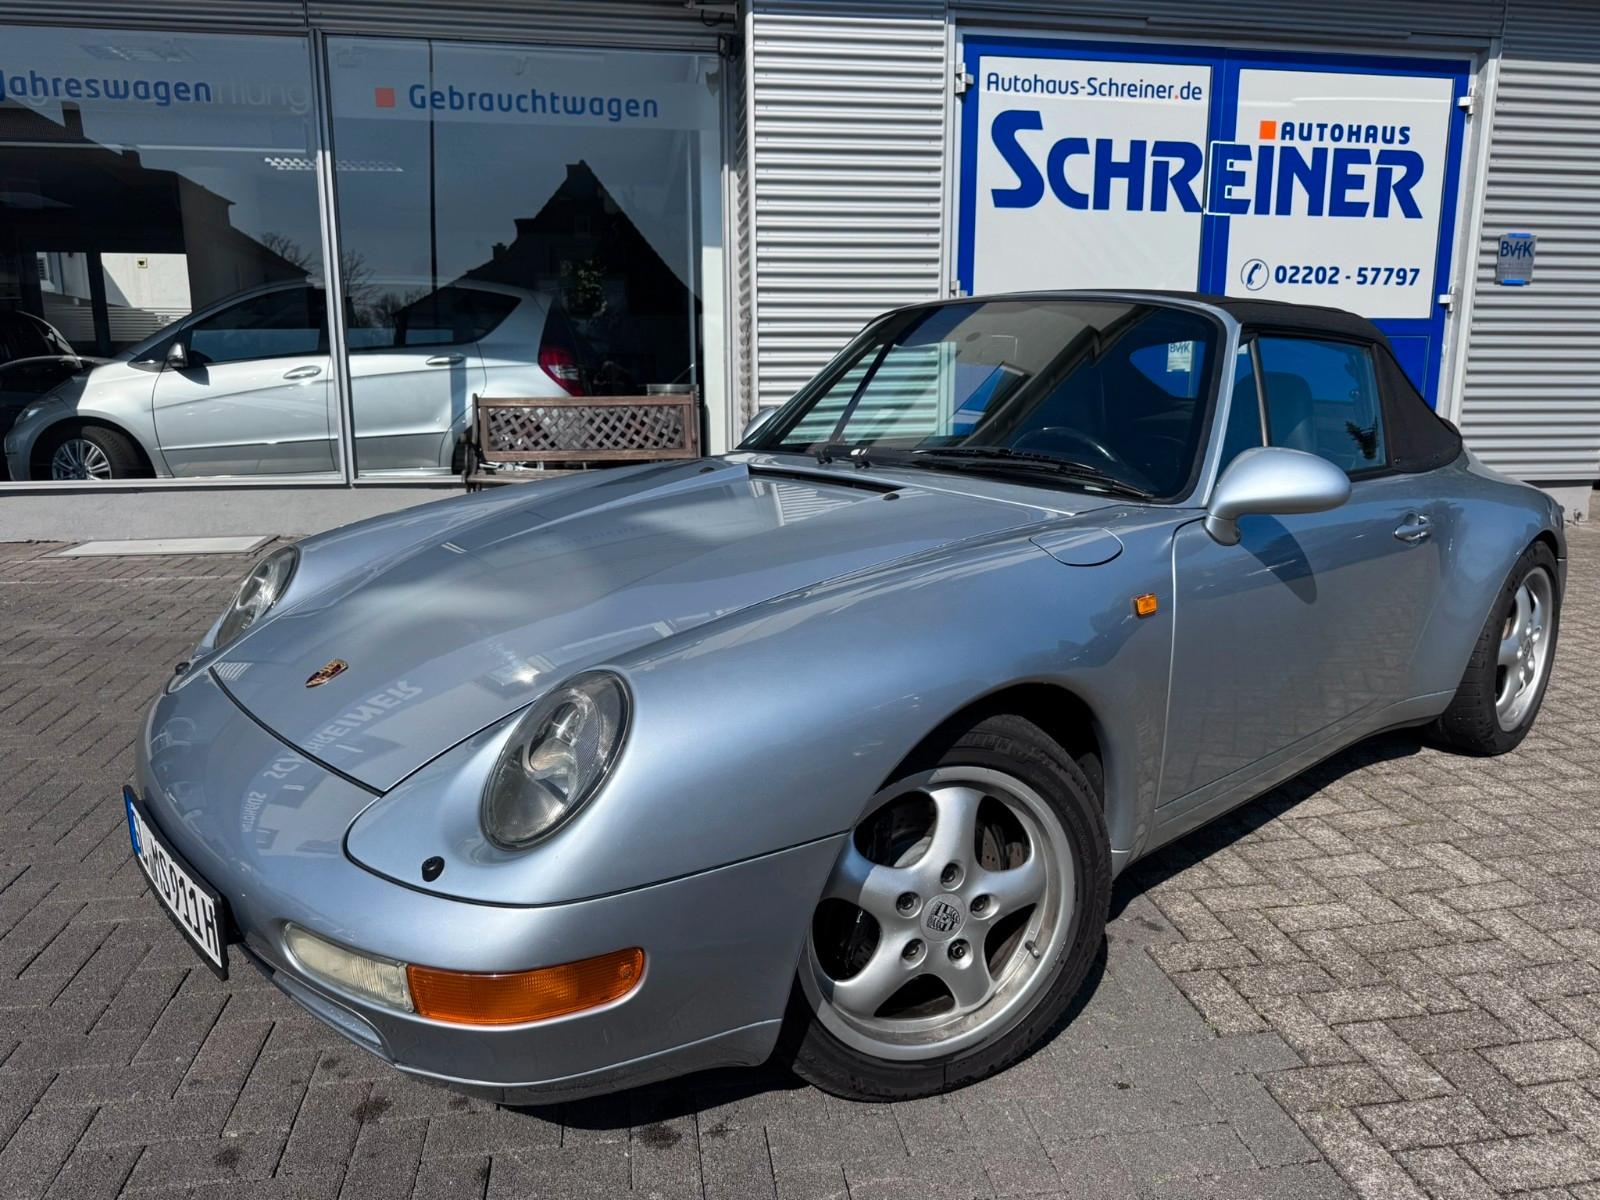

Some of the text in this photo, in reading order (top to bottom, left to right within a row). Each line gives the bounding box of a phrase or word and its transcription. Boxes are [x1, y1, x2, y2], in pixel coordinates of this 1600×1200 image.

[987, 72, 1202, 101] Autohaus-Schreiner.de
[409, 84, 658, 122] Gebrauchtwagen
[1280, 121, 1411, 145] AUTOHAUS
[991, 110, 1424, 219] SCHREINER
[1275, 265, 1340, 285] 02202
[1356, 266, 1421, 287] 57797
